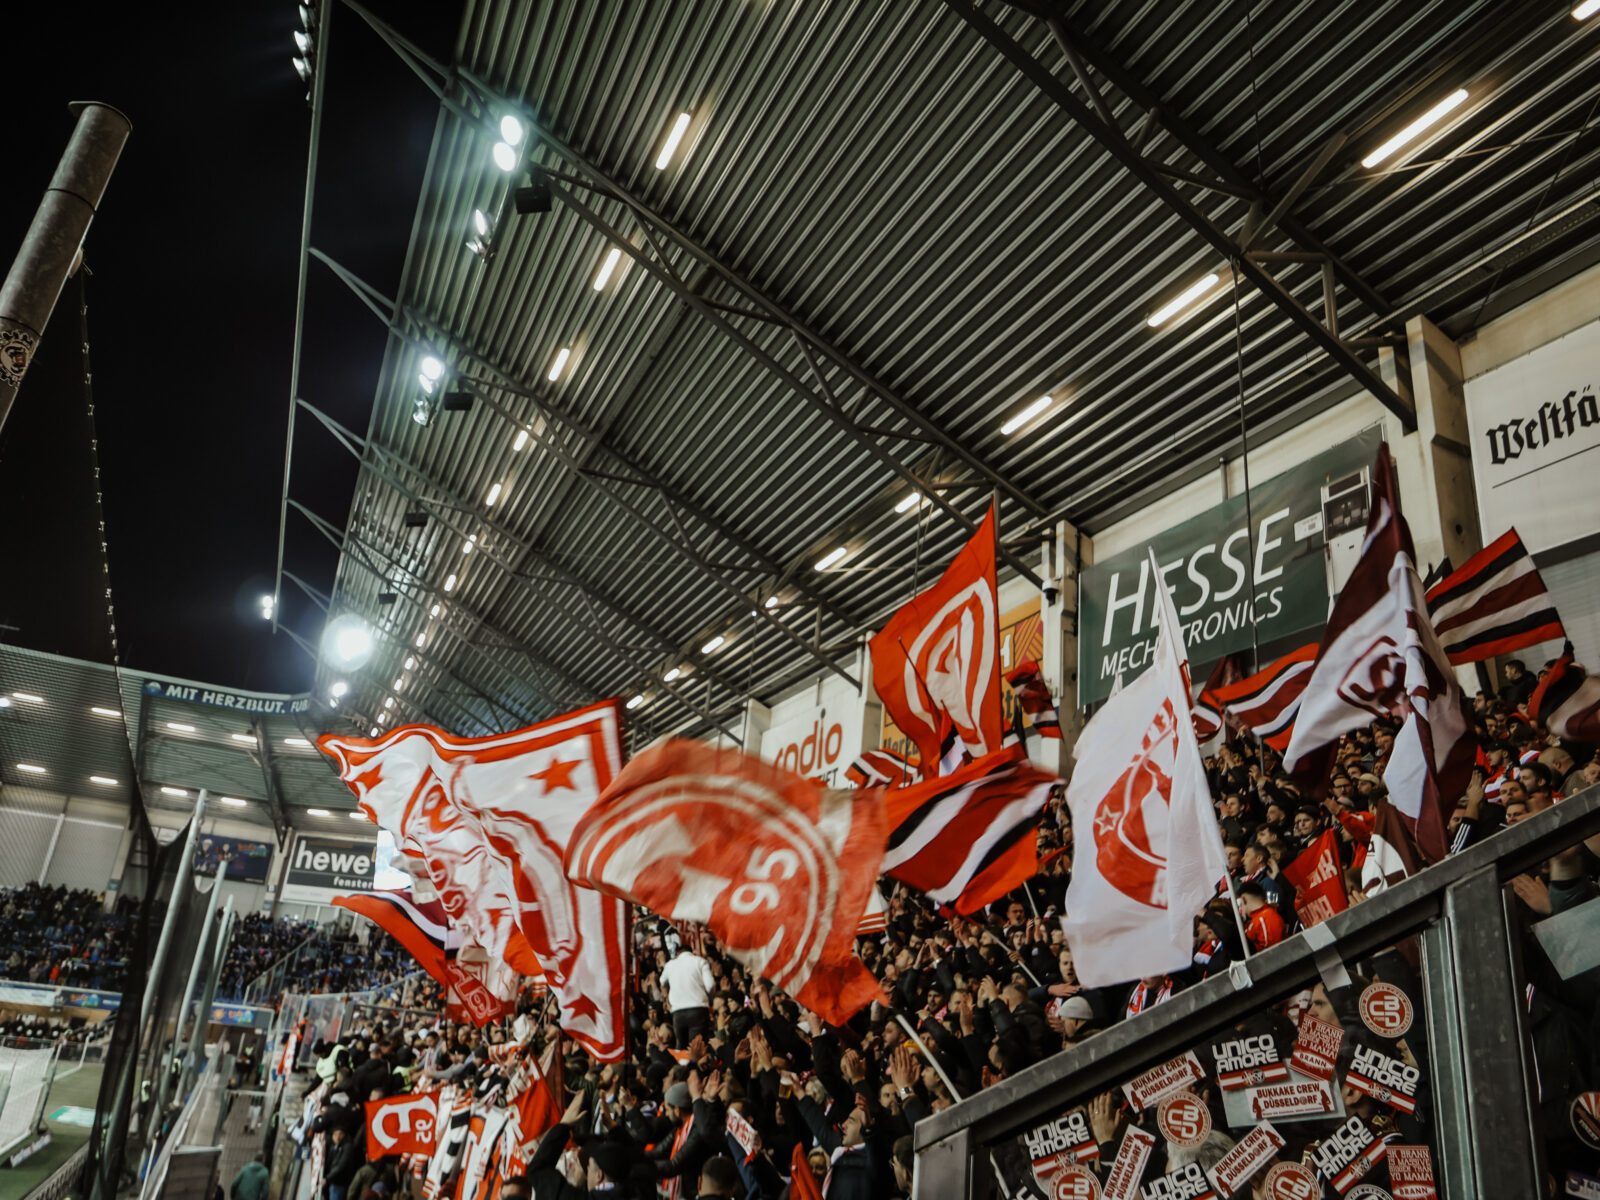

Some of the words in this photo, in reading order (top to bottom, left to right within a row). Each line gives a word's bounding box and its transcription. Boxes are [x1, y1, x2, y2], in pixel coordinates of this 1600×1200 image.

[1102, 508, 1290, 648] HESSE
[1100, 586, 1283, 680] MECHTRONICS
[165, 684, 199, 701] MIT
[202, 690, 286, 714] HERZBLUT.
[295, 839, 370, 875] hewe
[333, 875, 373, 890] fenster
[1212, 1034, 1274, 1060] UNICO
[1217, 1048, 1279, 1073] AMORE
[1299, 1052, 1327, 1068] BRANN
[1354, 1043, 1420, 1083] UNICO
[1131, 1066, 1166, 1091] BUKKAKE
[1165, 1055, 1188, 1072] CREW
[1257, 1085, 1296, 1098] BUKKAKE
[1296, 1083, 1320, 1094] CREW
[1350, 1058, 1417, 1097] AMORE
[1024, 1112, 1084, 1146] UNICO
[1029, 1126, 1090, 1160] AMORE
[1310, 1115, 1364, 1168] UNICO
[1104, 1159, 1125, 1199] BUKKAKE
[1119, 1133, 1135, 1159] CREW
[1214, 1144, 1246, 1176] BUKKAKE
[1245, 1126, 1266, 1151] CREW
[1321, 1128, 1375, 1180] AMORE
[1140, 1162, 1202, 1200] UNICO
[1399, 1187, 1429, 1195] BRANN
